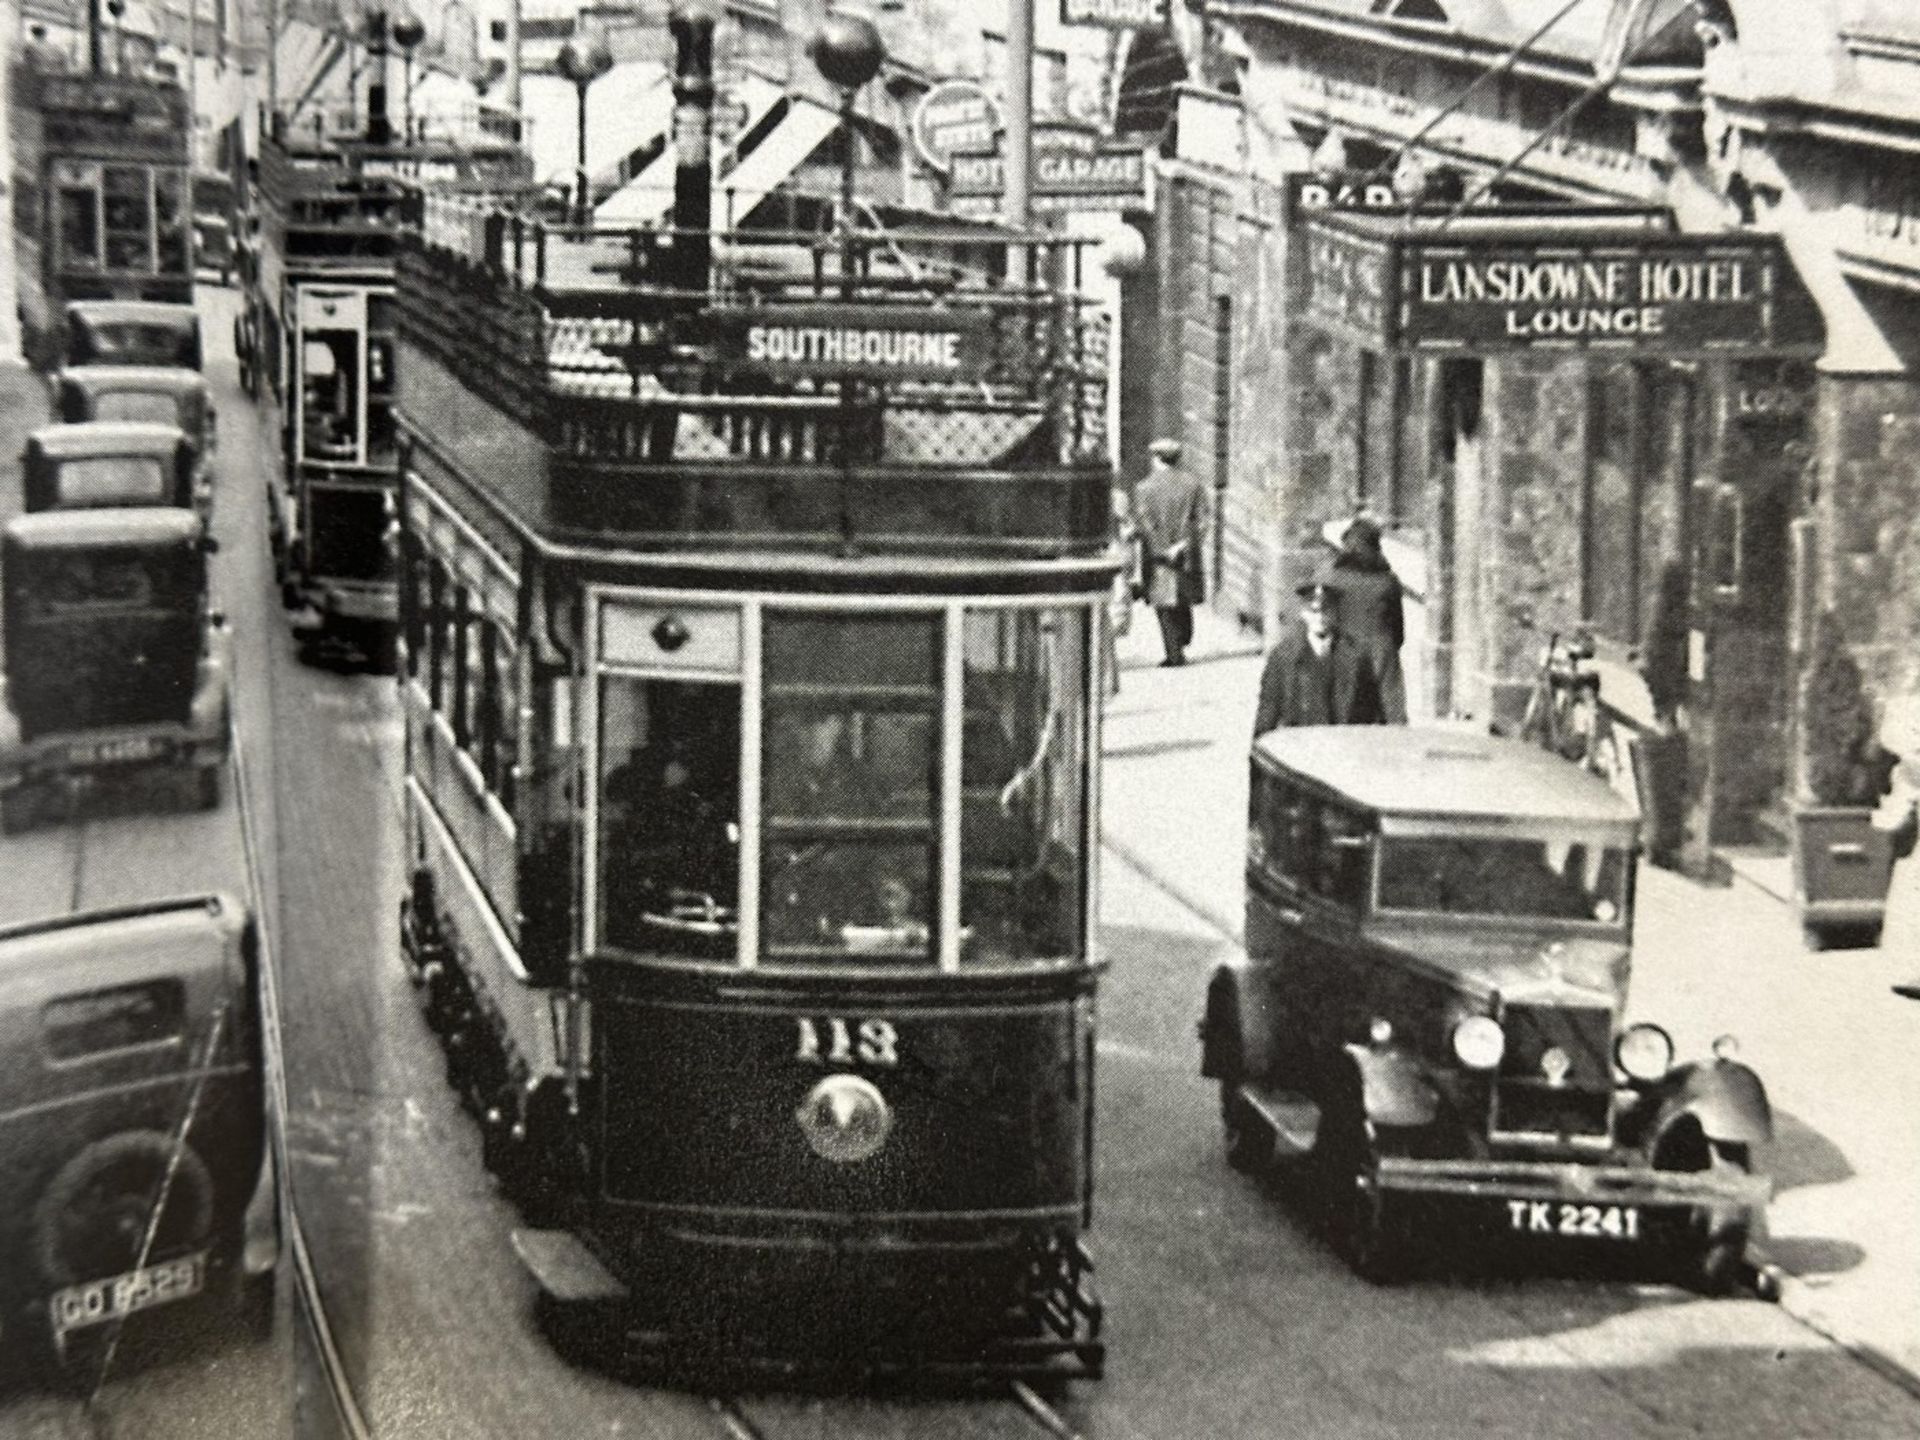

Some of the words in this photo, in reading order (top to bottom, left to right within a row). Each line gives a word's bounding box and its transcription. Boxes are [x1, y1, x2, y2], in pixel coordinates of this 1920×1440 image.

[1038, 157, 1140, 182] GARAGE
[1421, 262, 1626, 301] LANSDOWNE
[1639, 262, 1750, 301] HOTEL
[1505, 307, 1666, 335] LOUNGE
[748, 326, 961, 368] SOUTHBOURNE
[1508, 1199, 1551, 1232] TK
[1558, 1203, 1638, 1238] 2241
